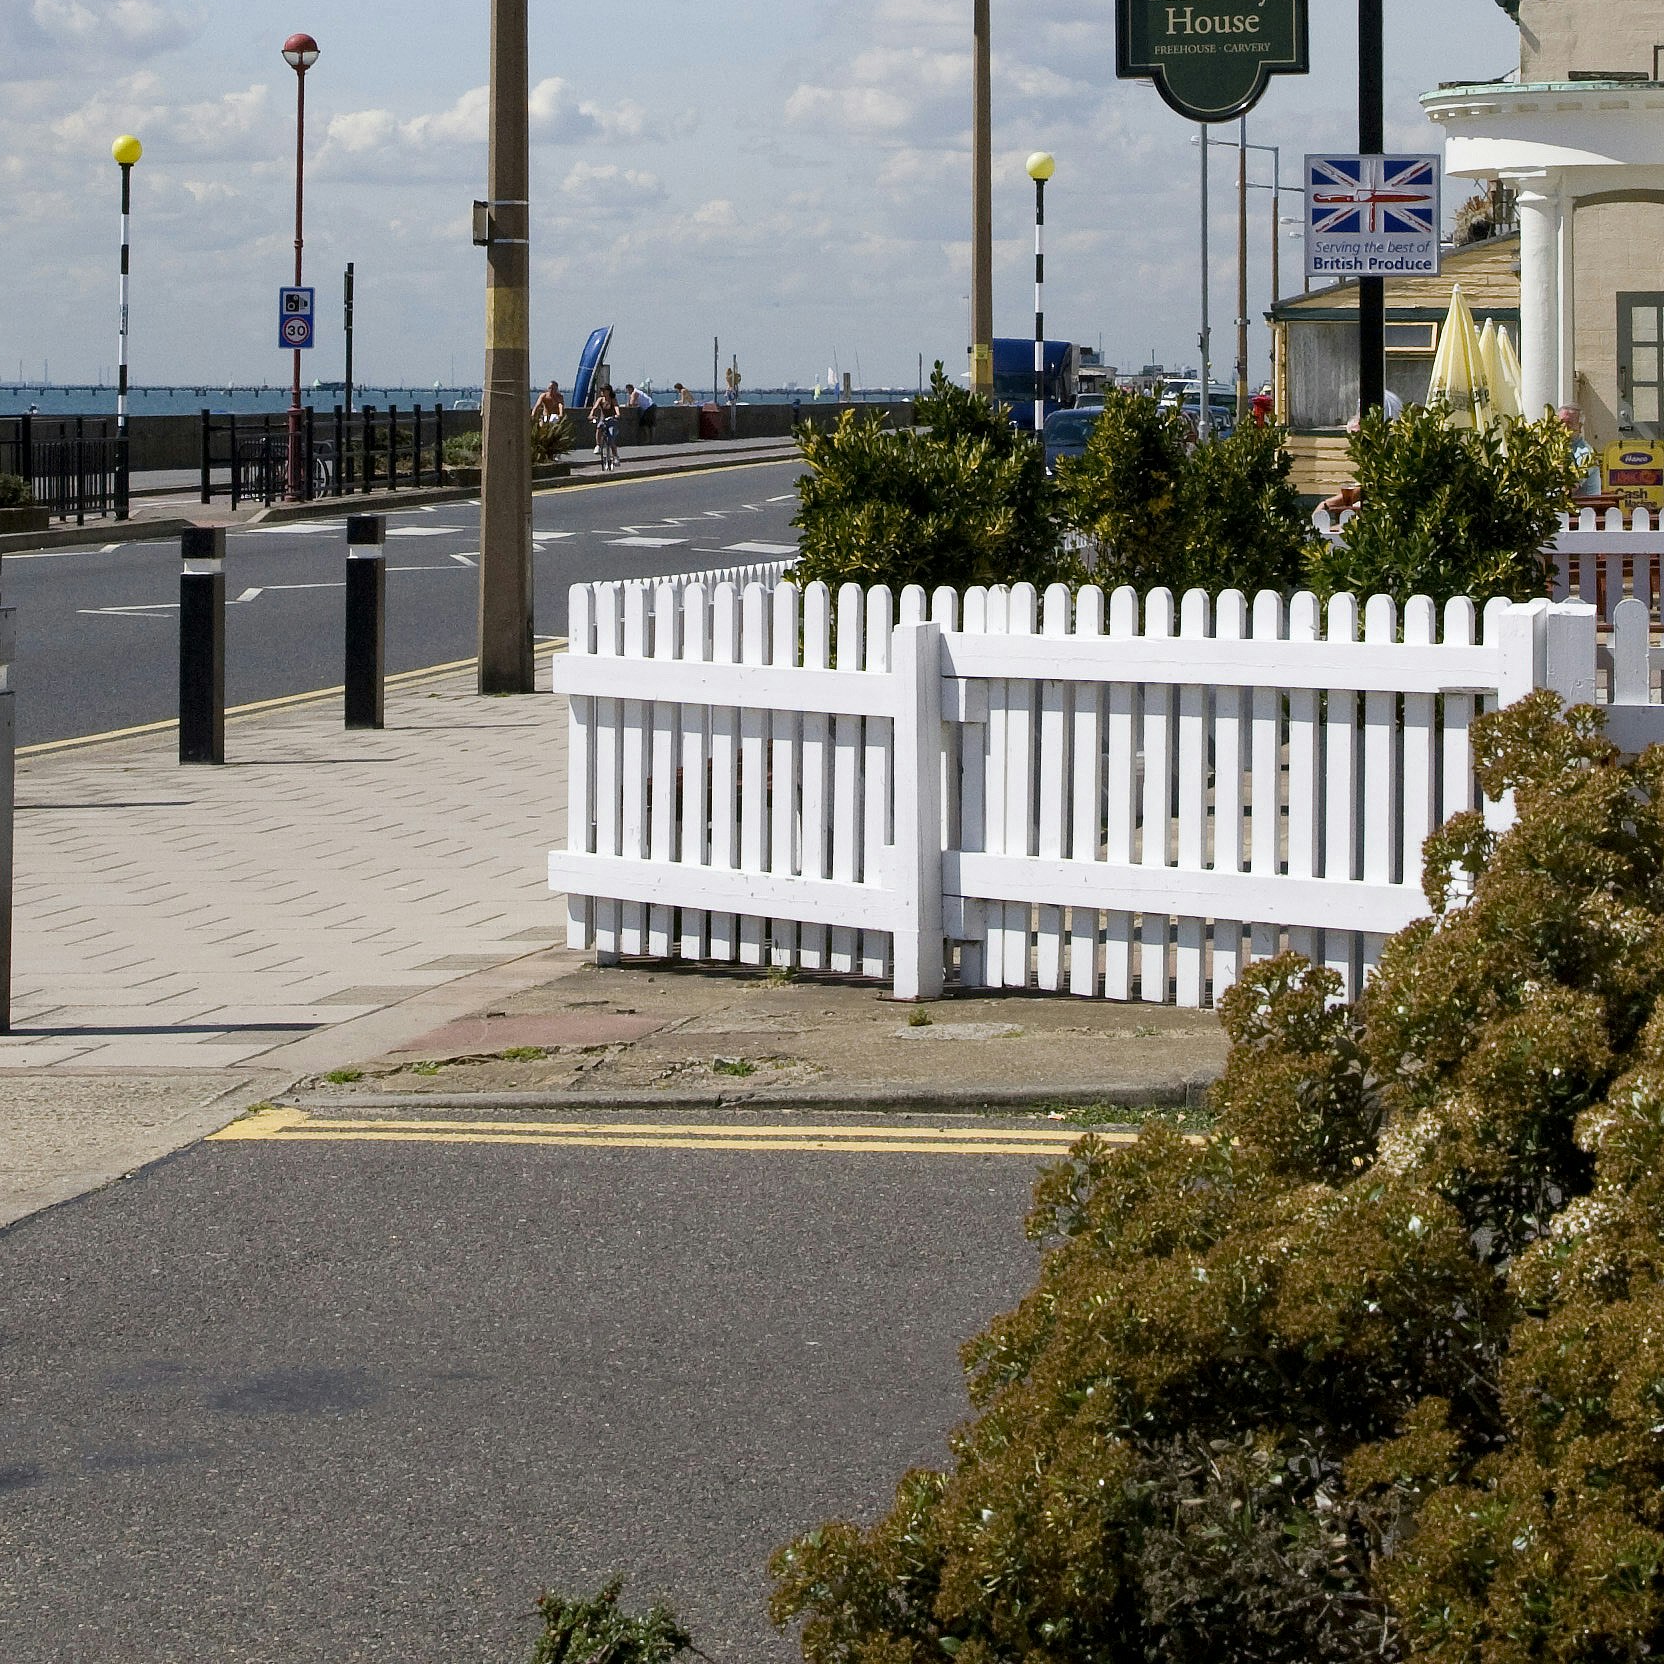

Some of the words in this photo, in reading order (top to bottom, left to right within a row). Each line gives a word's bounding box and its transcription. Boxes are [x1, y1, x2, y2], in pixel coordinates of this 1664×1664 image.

[1165, 7, 1260, 35] House
[1154, 44, 1217, 55] FREEHOUSE
[1223, 42, 1271, 53] CARVERY
[1315, 241, 1360, 255] Serving
[1364, 241, 1384, 253] the
[1387, 241, 1414, 253] best
[1417, 240, 1432, 253] of
[1313, 257, 1363, 270] British
[1368, 257, 1432, 270] Produce
[287, 325, 306, 336] 30
